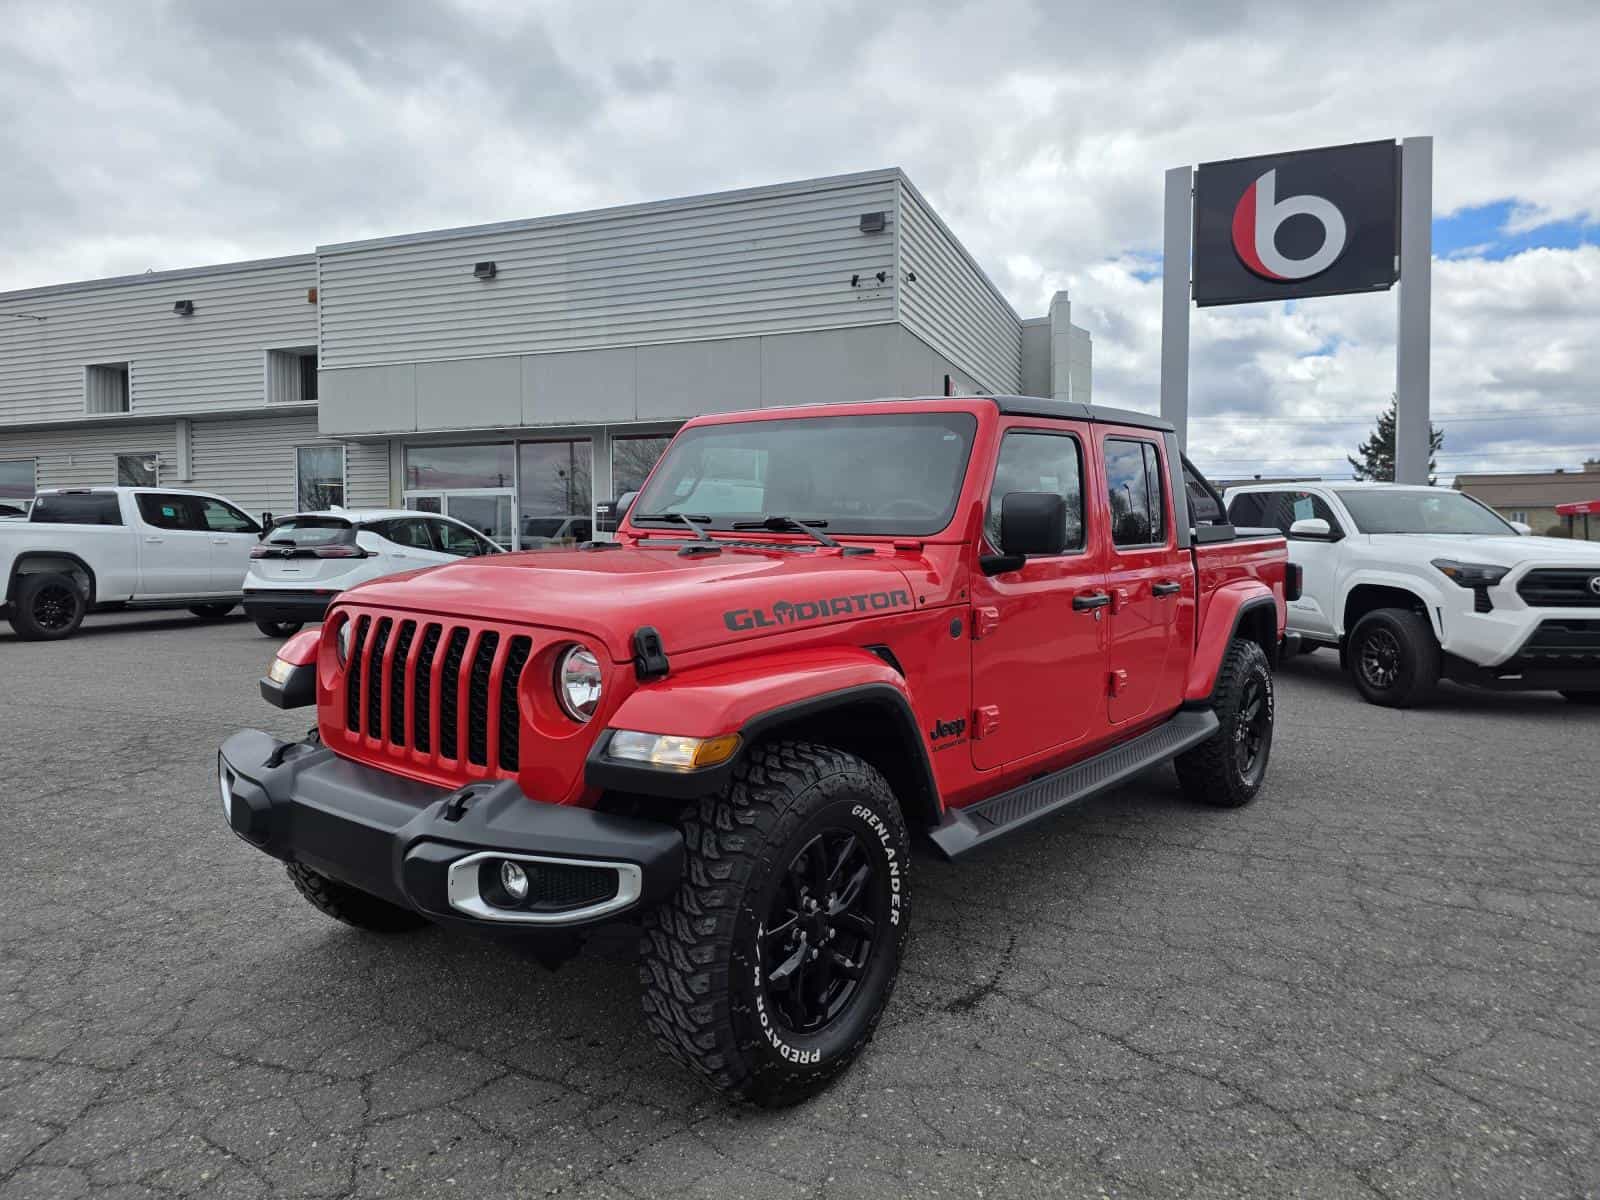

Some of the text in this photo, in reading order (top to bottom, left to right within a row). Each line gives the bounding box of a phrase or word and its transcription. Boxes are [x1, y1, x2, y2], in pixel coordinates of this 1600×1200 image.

[723, 589, 910, 631] GLADIATOR
[930, 719, 966, 740] Jeep
[851, 804, 901, 927] GRENLANDER
[756, 994, 821, 1065] PREDATOR
